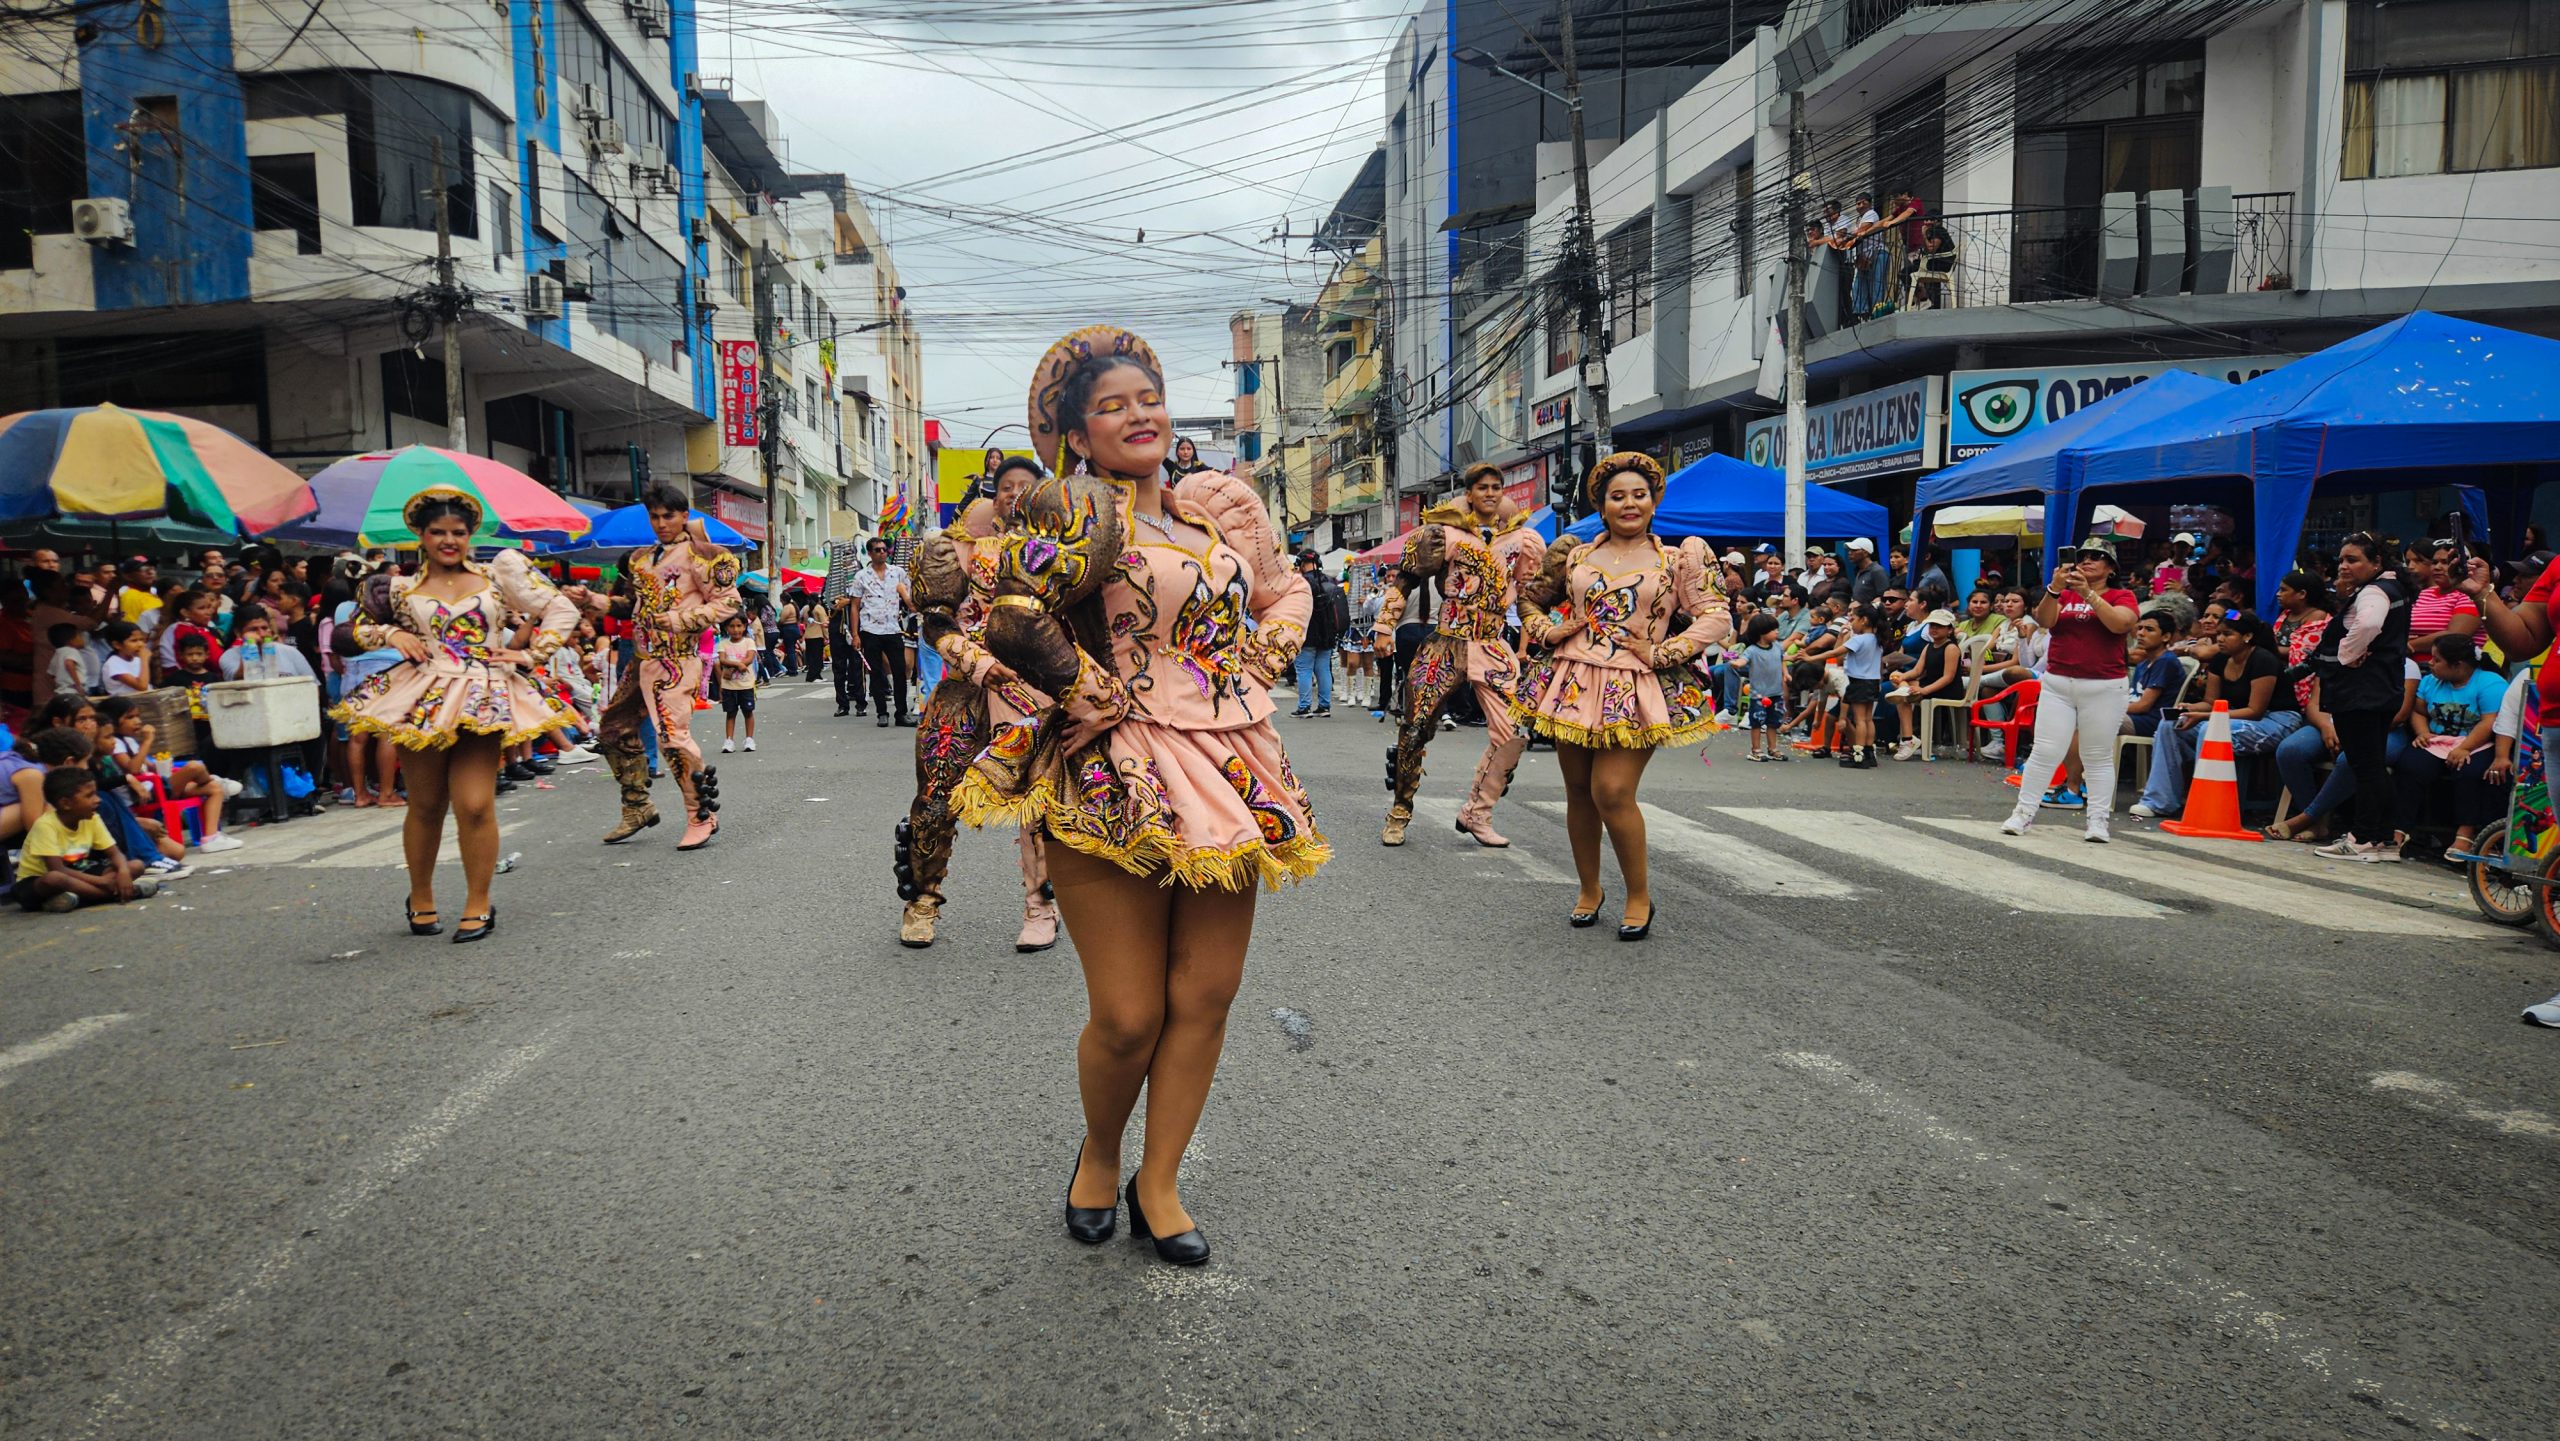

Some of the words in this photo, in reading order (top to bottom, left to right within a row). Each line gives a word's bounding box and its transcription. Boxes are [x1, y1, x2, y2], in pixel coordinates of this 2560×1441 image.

[724, 342, 738, 445] farmacias
[742, 369, 755, 439] suiza
[1684, 436, 1711, 453] GOLDEN
[1773, 416, 1827, 467] OCA
[1831, 391, 1921, 457] MEGALENS
[1957, 447, 1992, 458] OPTO
